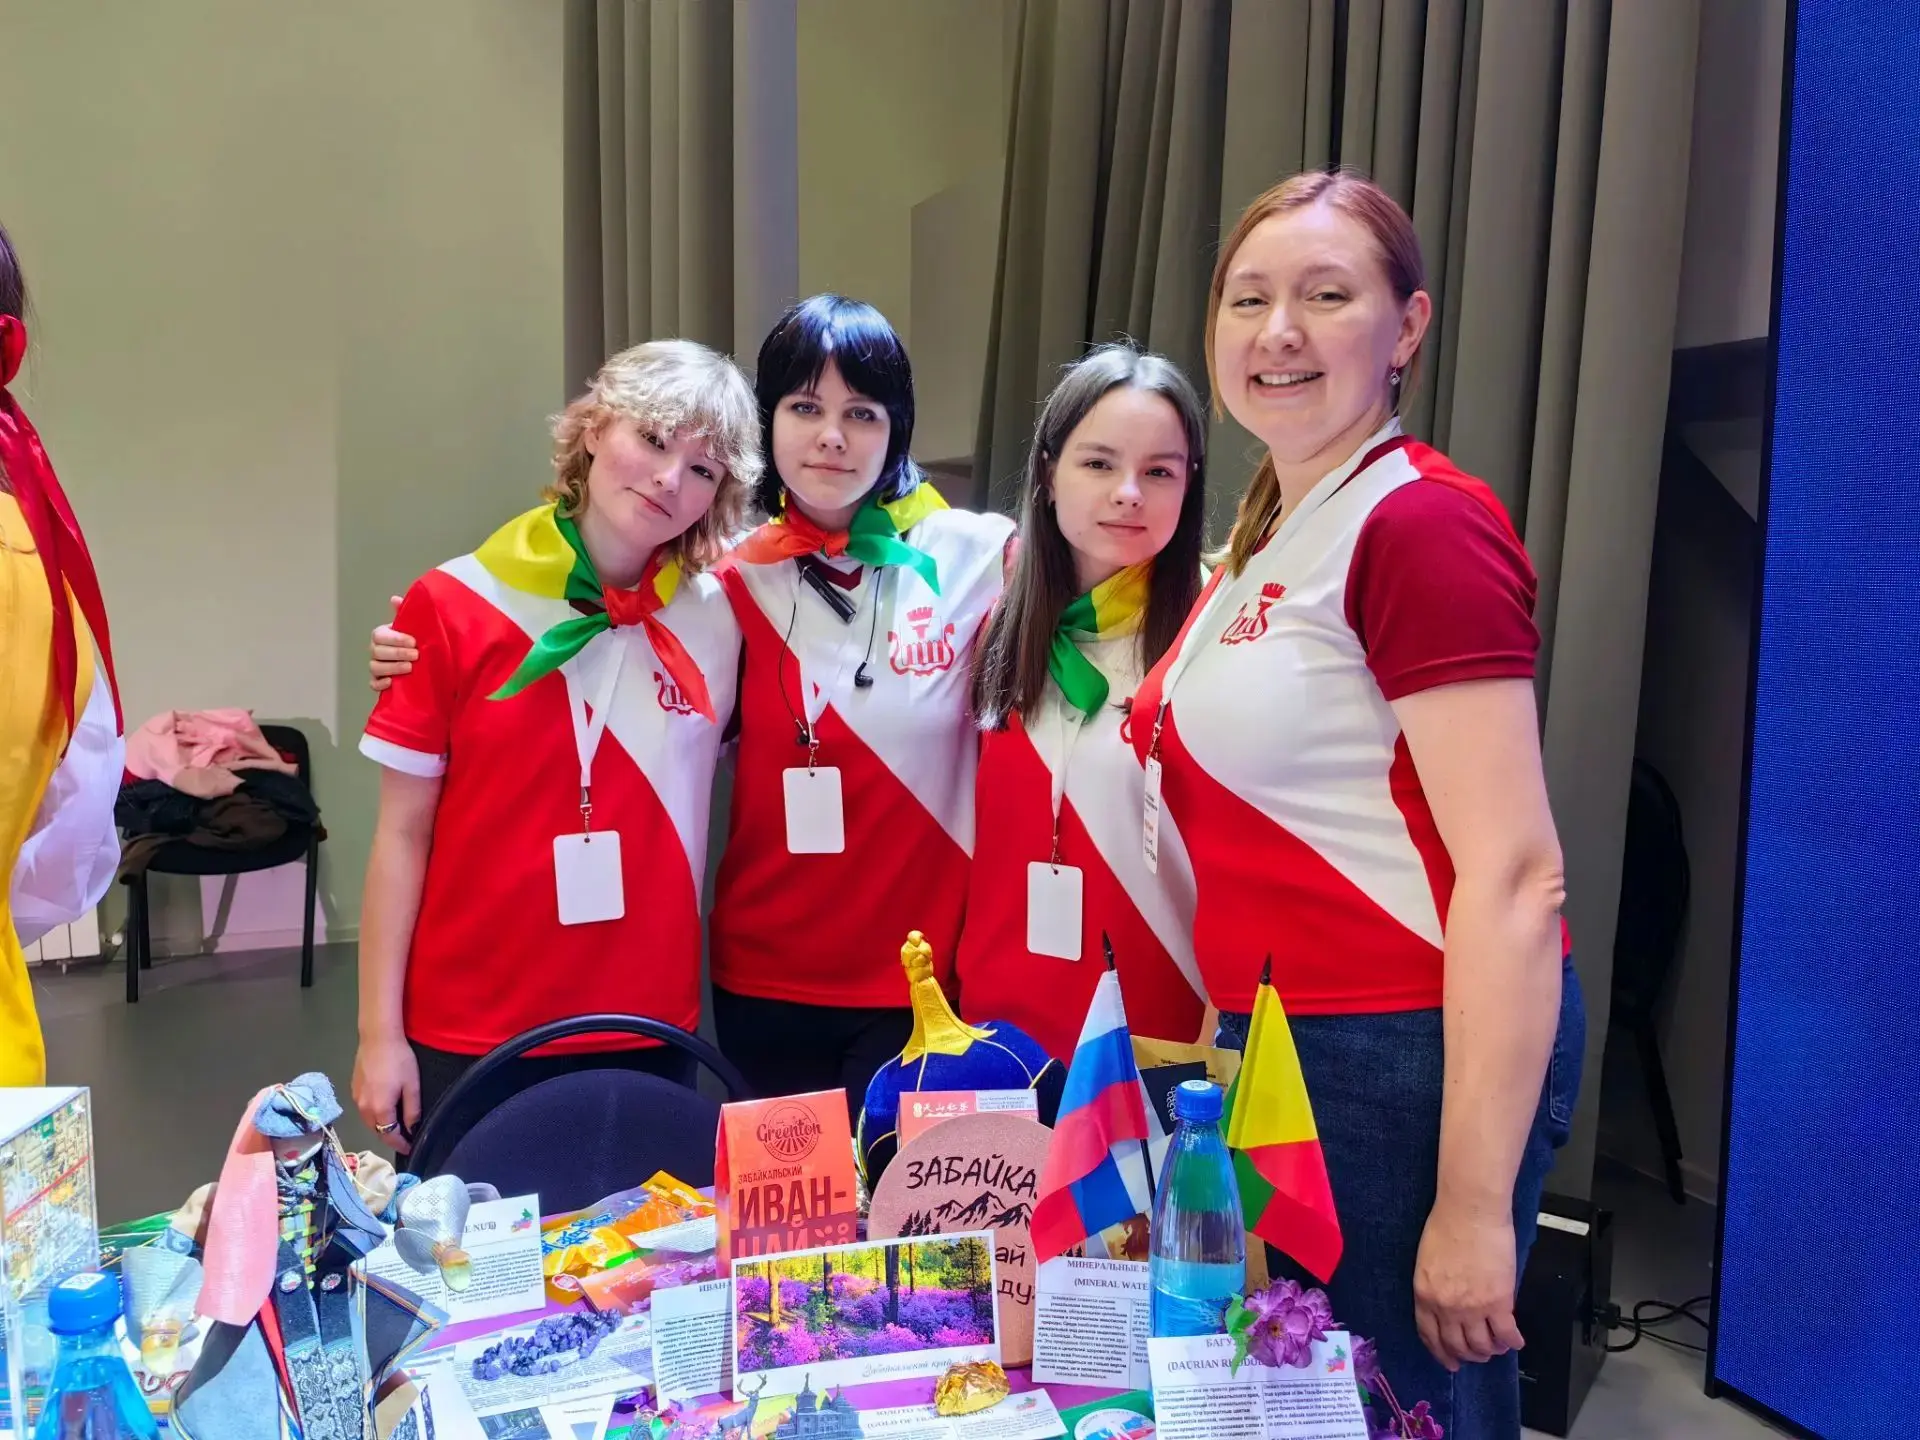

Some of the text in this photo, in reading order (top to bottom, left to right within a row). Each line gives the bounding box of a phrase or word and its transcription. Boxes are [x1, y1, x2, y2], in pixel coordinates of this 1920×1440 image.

[756, 1119, 823, 1143] Greenton
[738, 1164, 803, 1184] ЗАБАЙКАЛЬСКИЙ
[906, 1153, 1038, 1201] ЗАБАЙКА
[738, 1175, 847, 1230] ИВАН-
[1067, 1259, 1139, 1273] МИНЕРАЛЬНЫЕ
[1074, 1278, 1149, 1291] (MINERAL WATE
[1205, 1338, 1236, 1348] БАГУ
[1167, 1359, 1219, 1373] (DAURIAN
